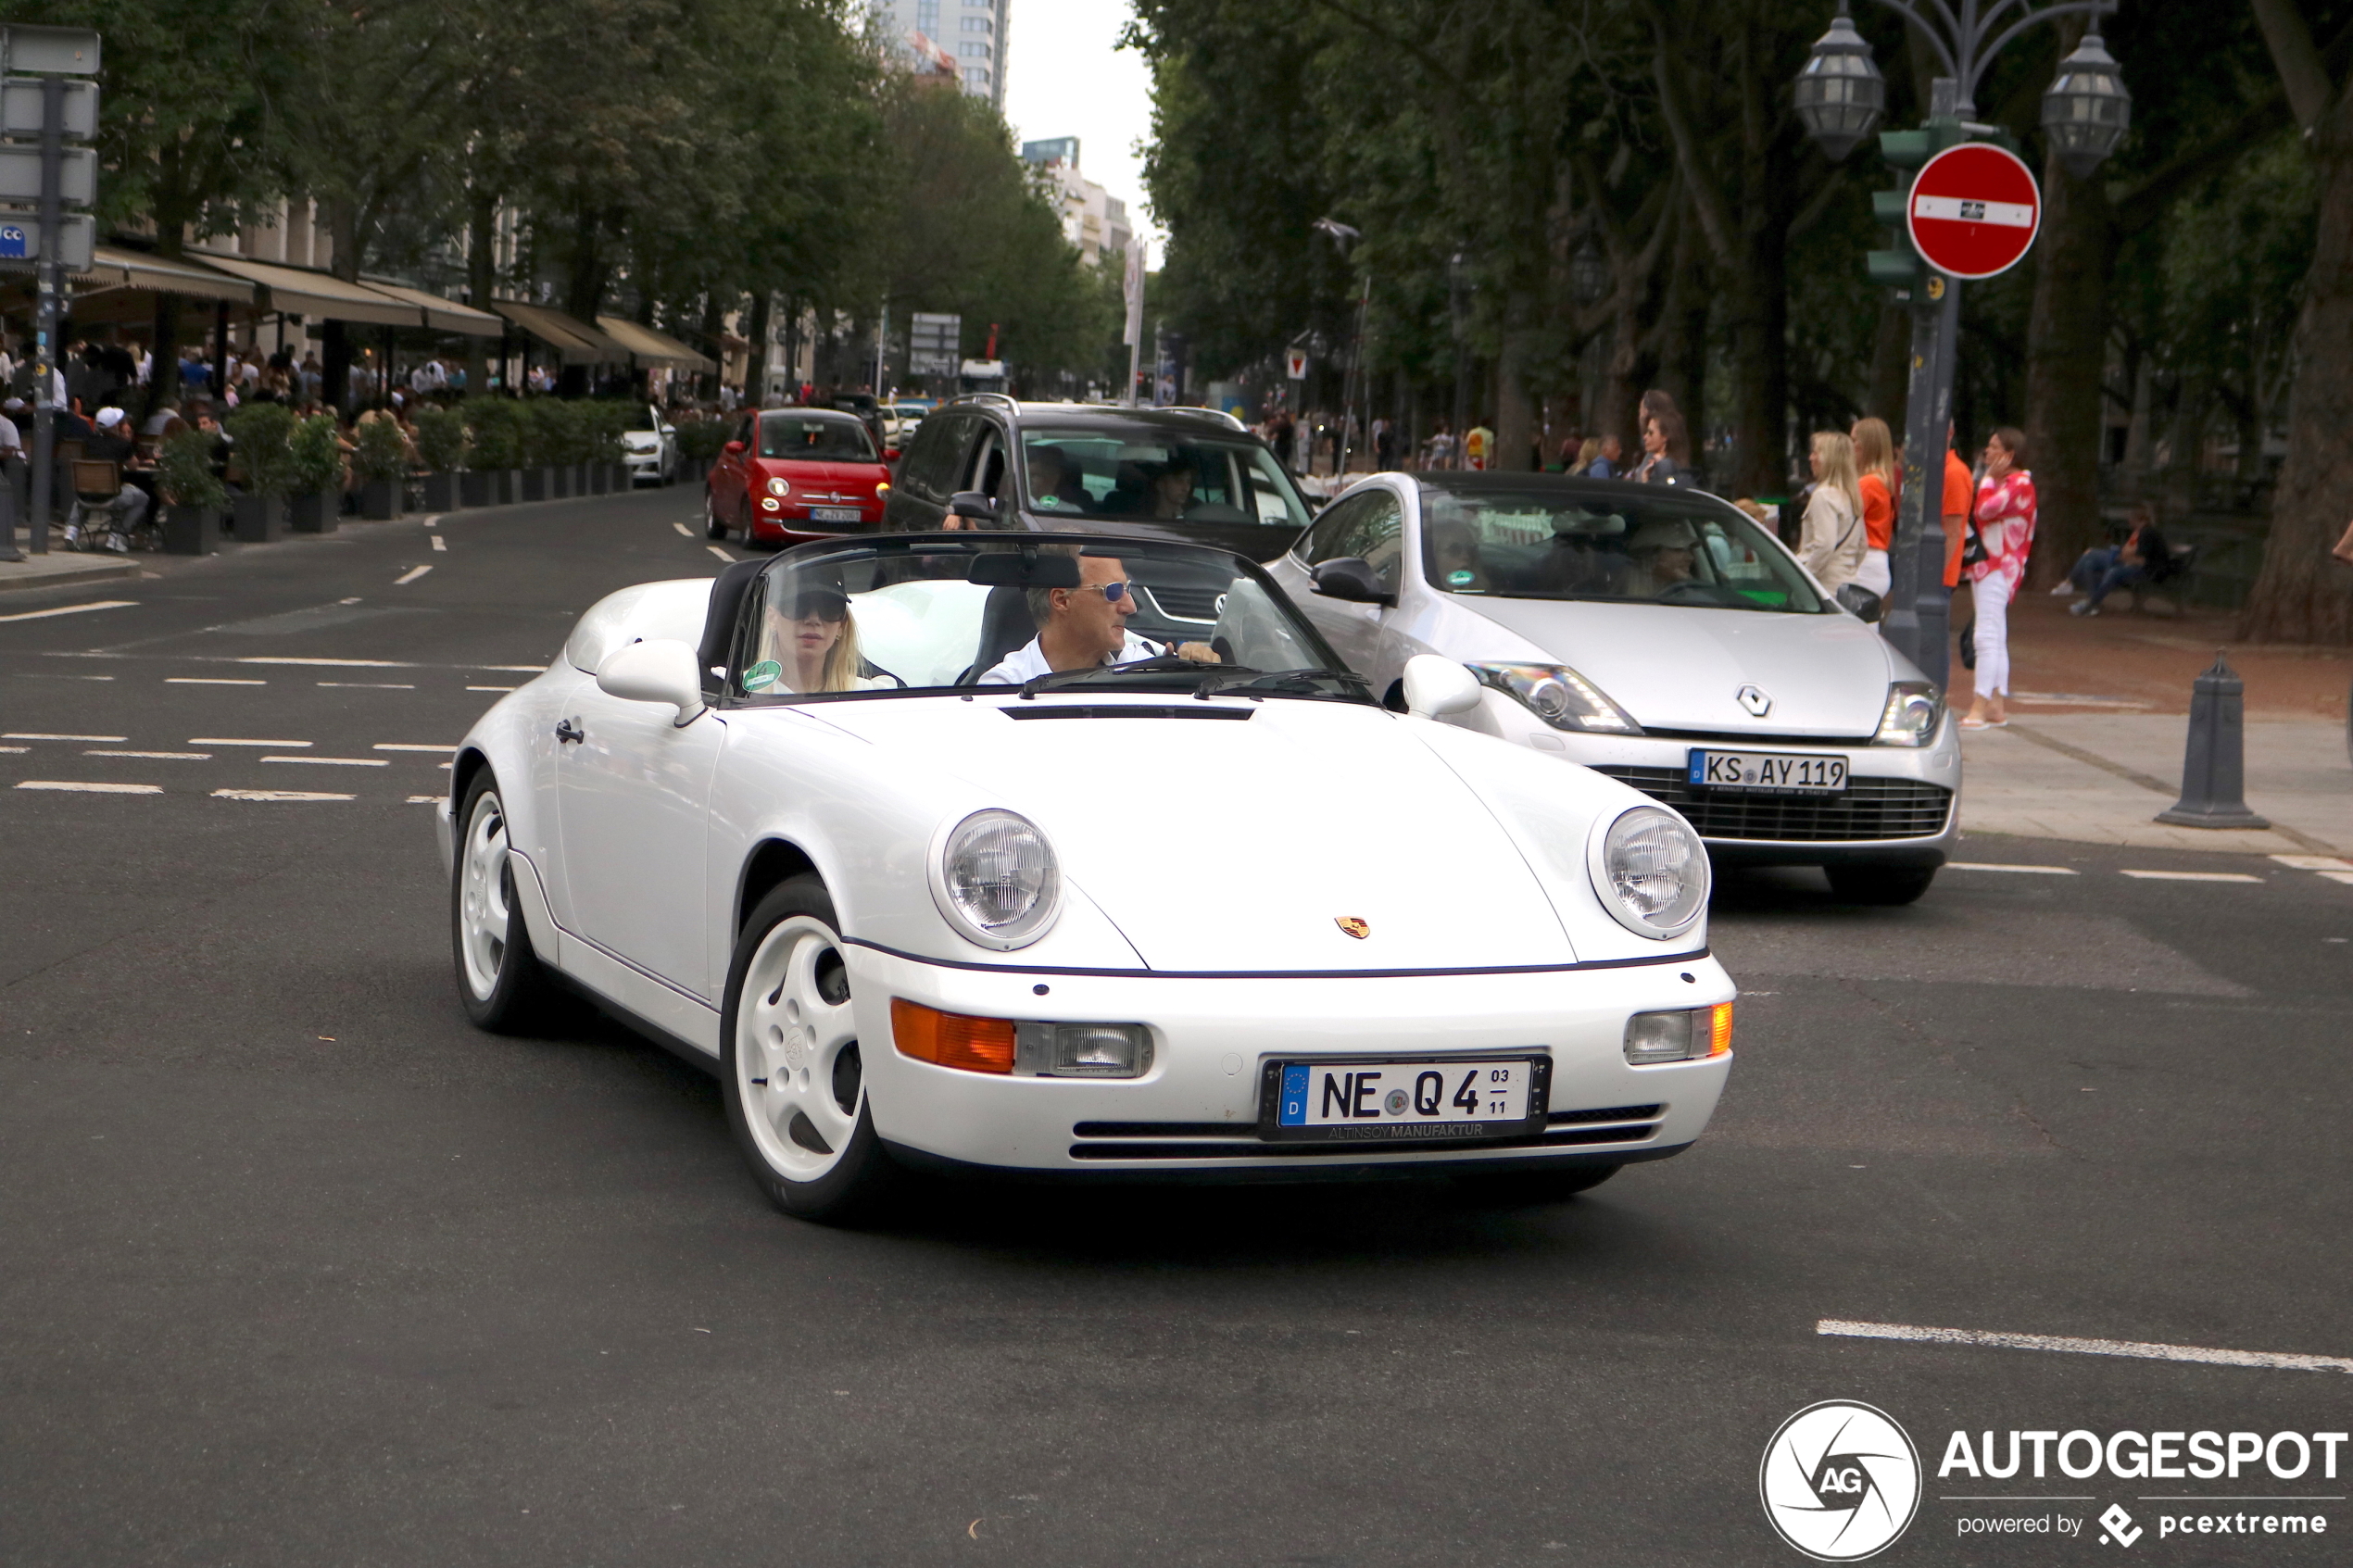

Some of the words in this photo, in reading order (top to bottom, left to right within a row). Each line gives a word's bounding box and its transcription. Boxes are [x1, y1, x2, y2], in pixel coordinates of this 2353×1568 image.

[757, 661, 767, 674] 4
[1693, 770, 1701, 779] D
[1707, 756, 1742, 782] KS
[1760, 759, 1793, 784] AY
[1798, 760, 1844, 786] 119
[1491, 1069, 1508, 1083] 03
[1290, 1102, 1299, 1115] D
[1322, 1072, 1381, 1119] NE
[1415, 1071, 1443, 1115] Q
[1453, 1070, 1479, 1115] 4
[1490, 1101, 1505, 1114] 11
